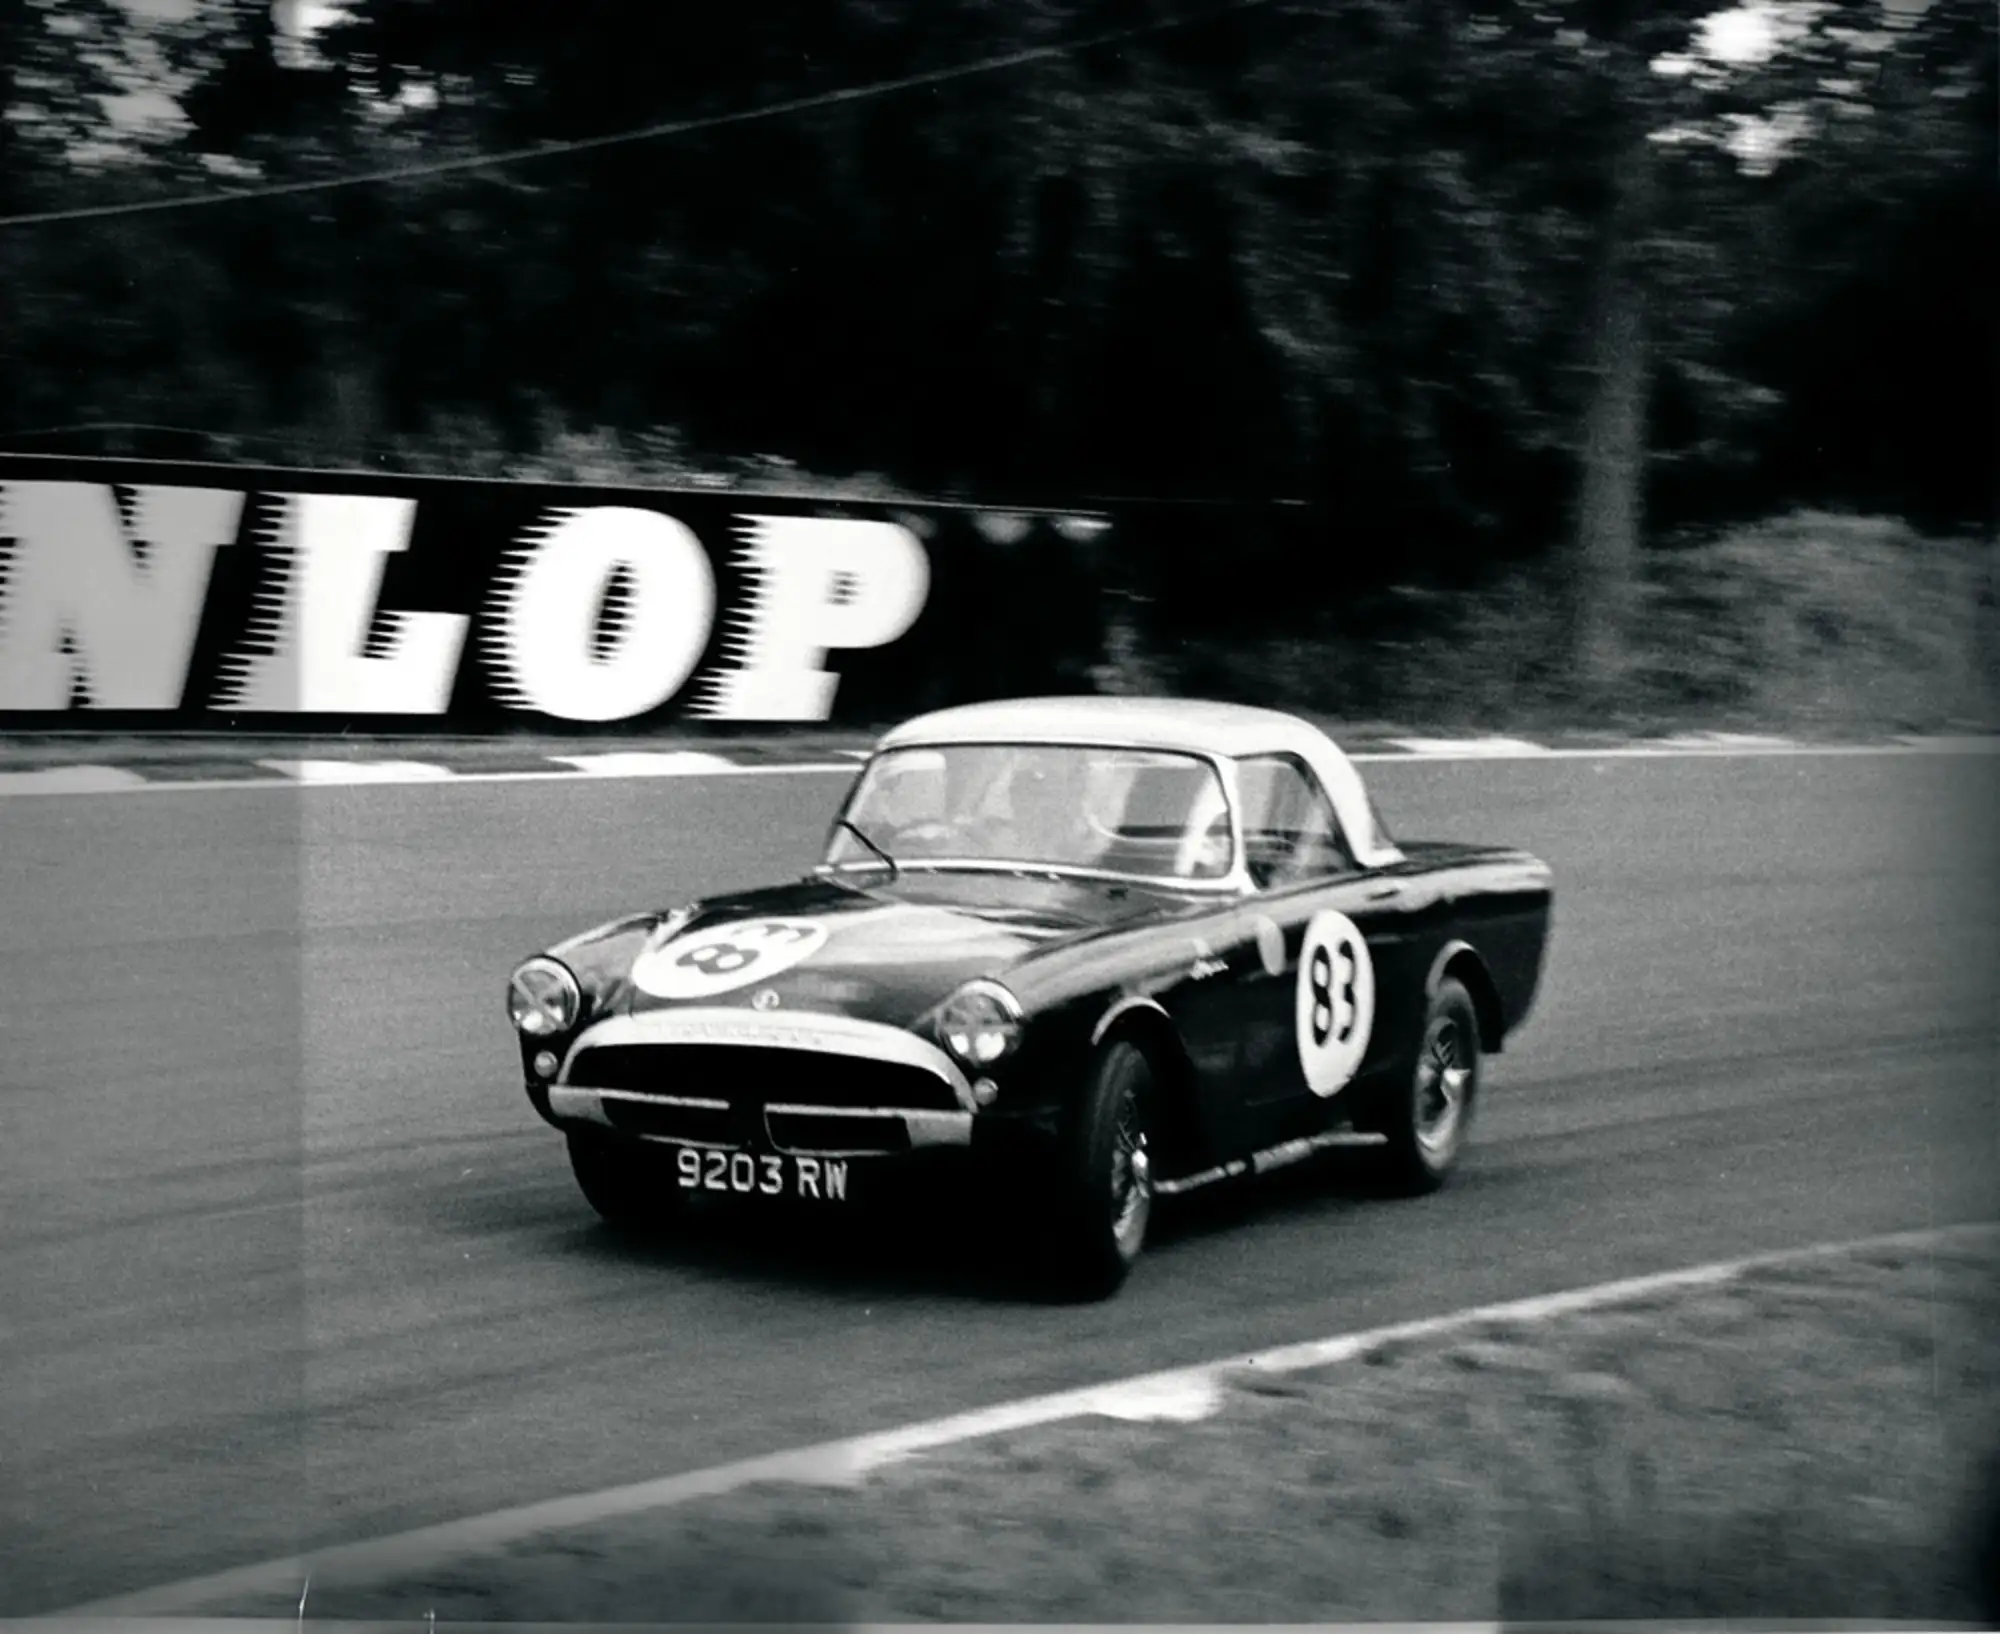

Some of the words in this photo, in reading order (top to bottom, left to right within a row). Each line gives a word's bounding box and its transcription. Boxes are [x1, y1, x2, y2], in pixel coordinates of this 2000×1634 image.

[675, 923, 817, 975] 83
[1311, 938, 1358, 1047] 83
[677, 1147, 783, 1194] 9203
[795, 1156, 848, 1201] RW
